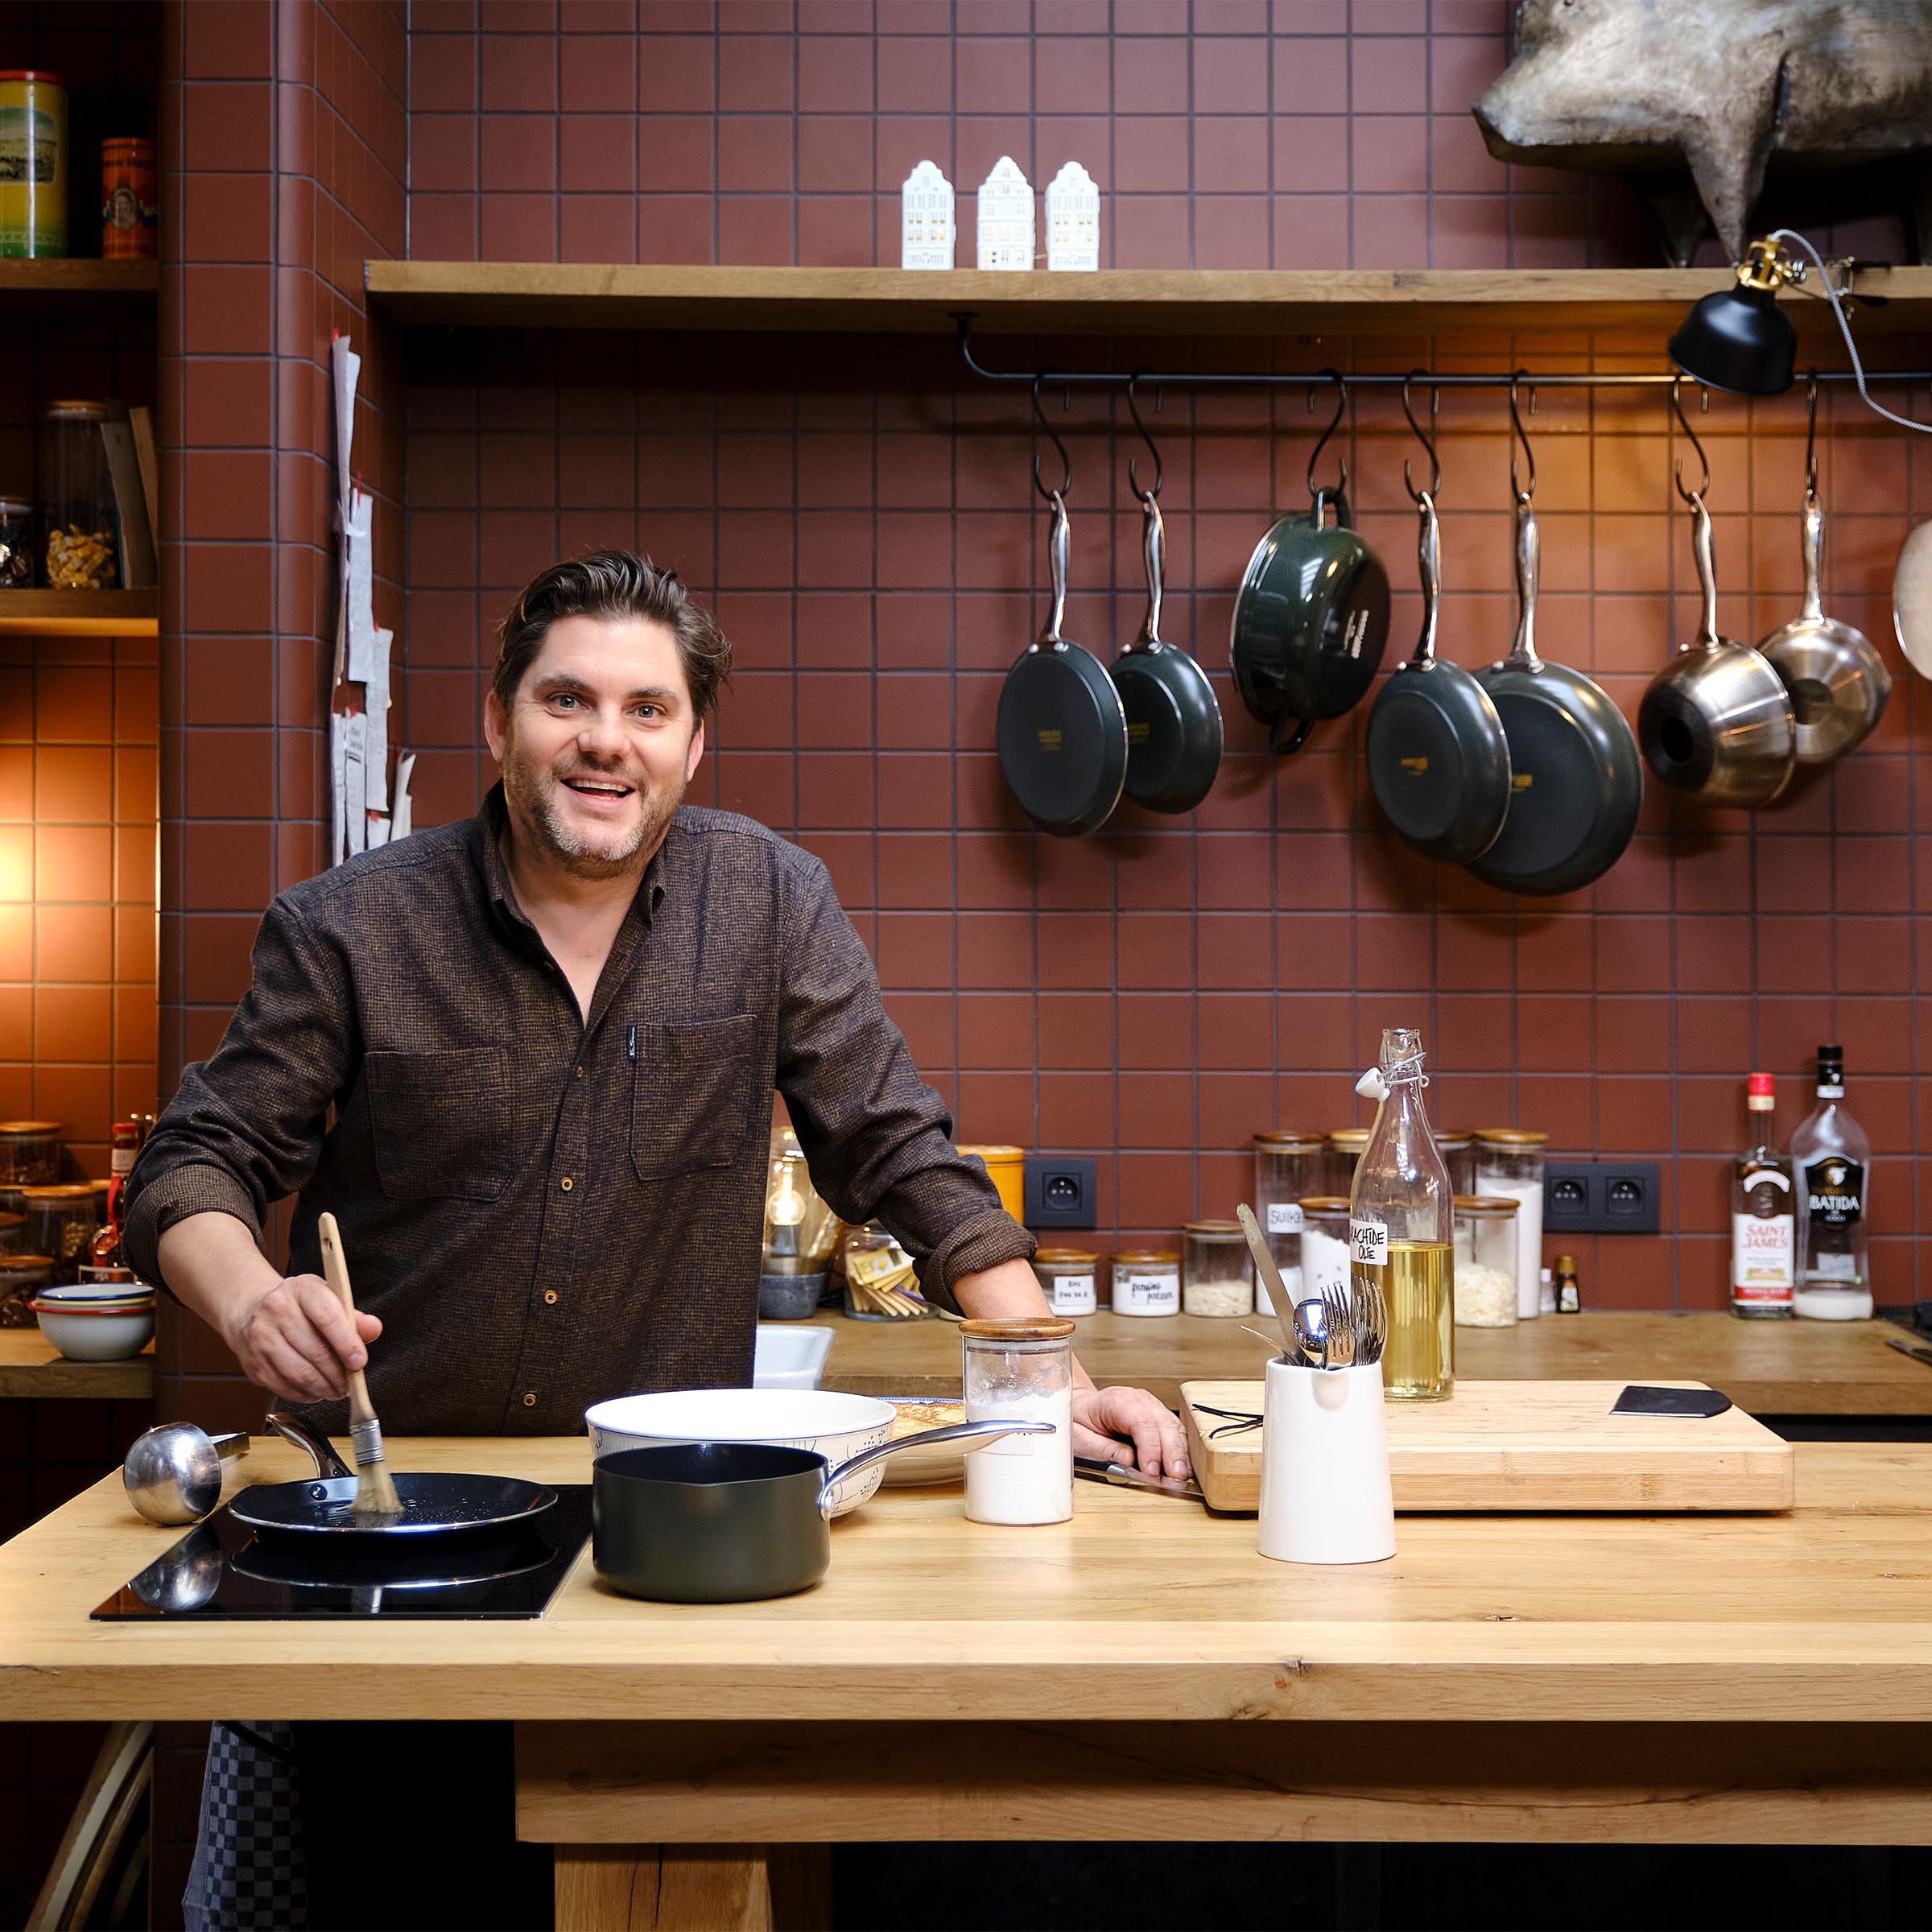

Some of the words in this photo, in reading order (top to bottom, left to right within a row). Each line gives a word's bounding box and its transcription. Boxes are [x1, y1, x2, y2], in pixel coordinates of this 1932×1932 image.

[1808, 1195, 1860, 1211] BATIDA
[1745, 1224, 1786, 1237] SAINT
[1741, 1236, 1789, 1249] JAMES
